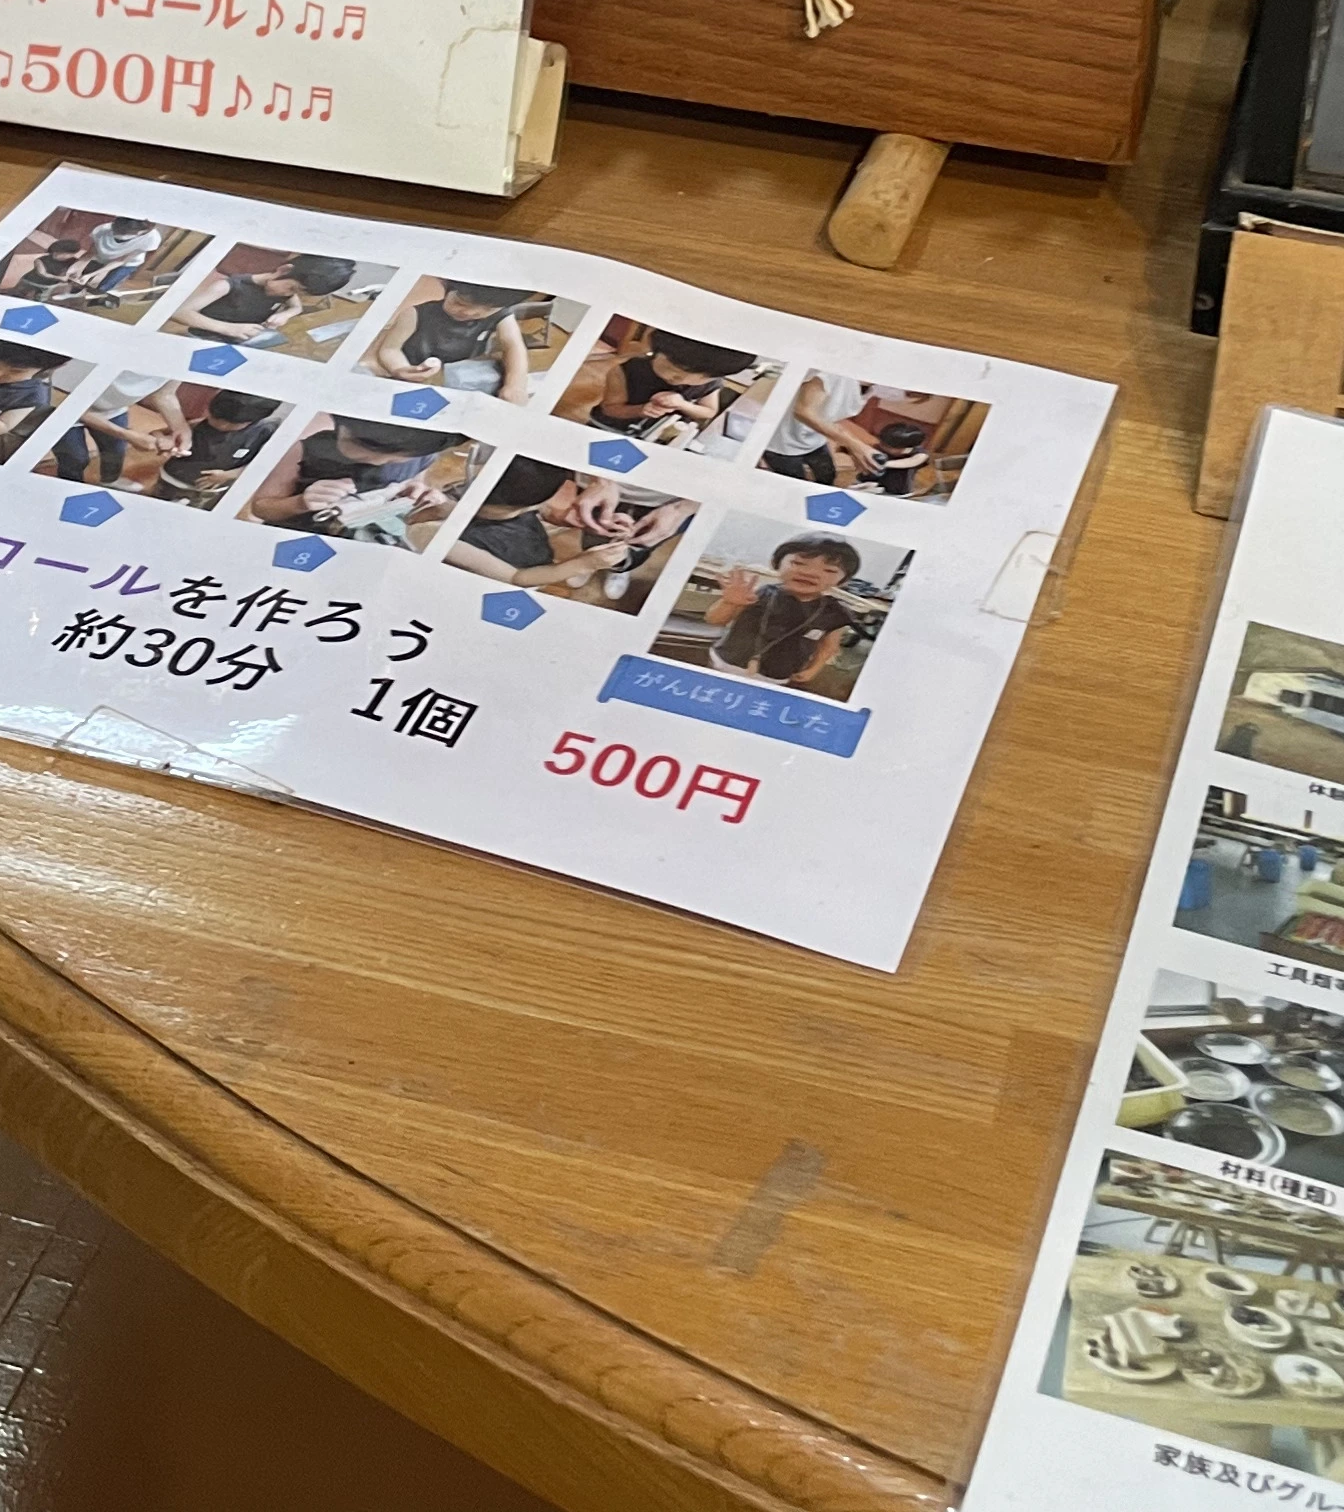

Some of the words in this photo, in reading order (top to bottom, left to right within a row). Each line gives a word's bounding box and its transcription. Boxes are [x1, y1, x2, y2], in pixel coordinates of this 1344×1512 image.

[21, 43, 216, 118] 500円
[50, 608, 284, 692] 約30分
[349, 678, 480, 749] 1個
[543, 730, 761, 825] 500円
[632, 670, 833, 736] がんばりました
